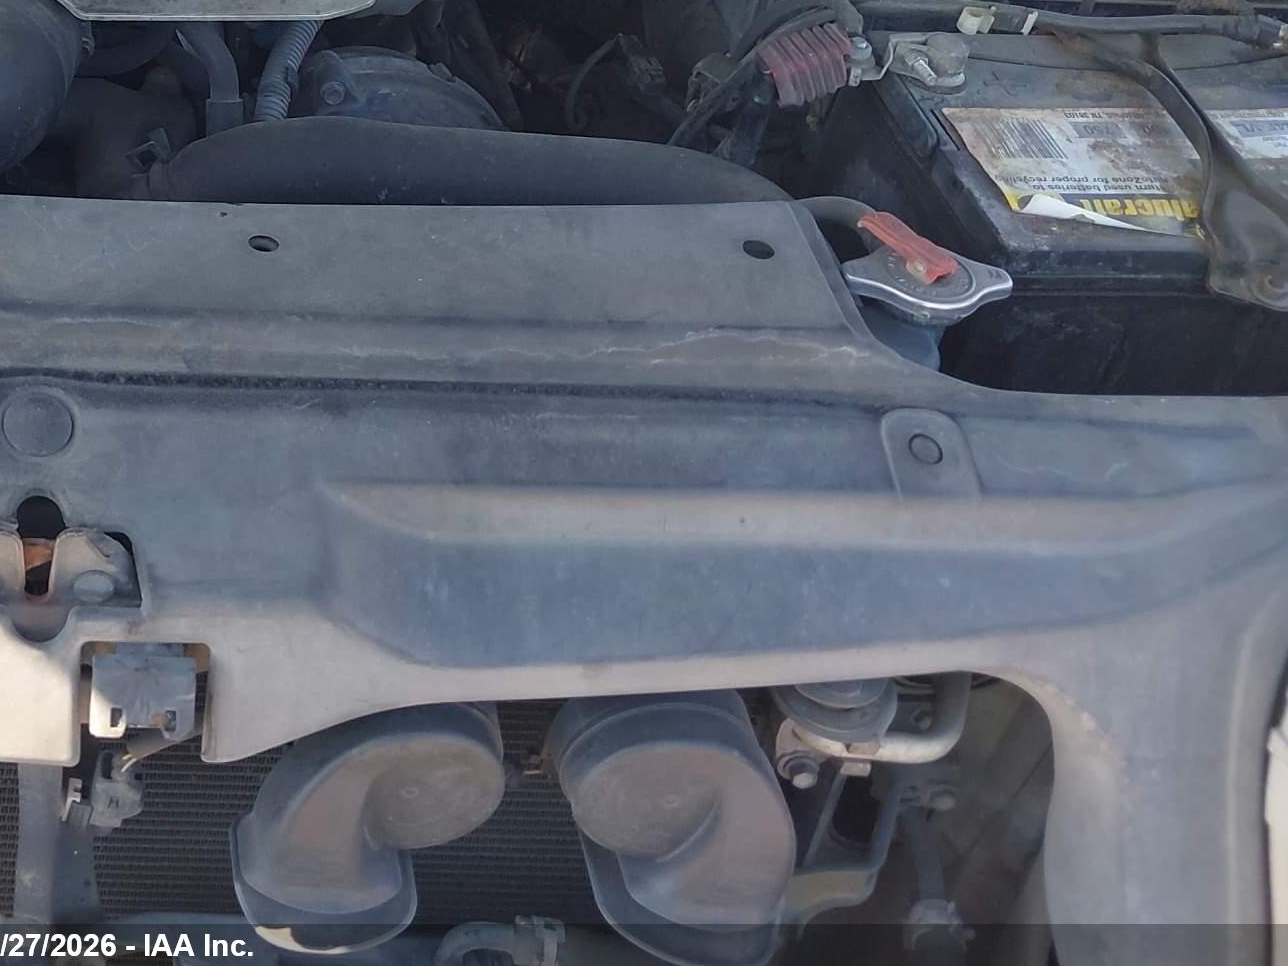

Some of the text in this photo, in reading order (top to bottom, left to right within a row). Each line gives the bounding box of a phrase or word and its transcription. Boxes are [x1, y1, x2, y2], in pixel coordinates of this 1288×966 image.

[1051, 175, 1089, 185] proper
[1092, 176, 1109, 184] for
[1047, 183, 1101, 192] batteries
[1103, 184, 1132, 192] used
